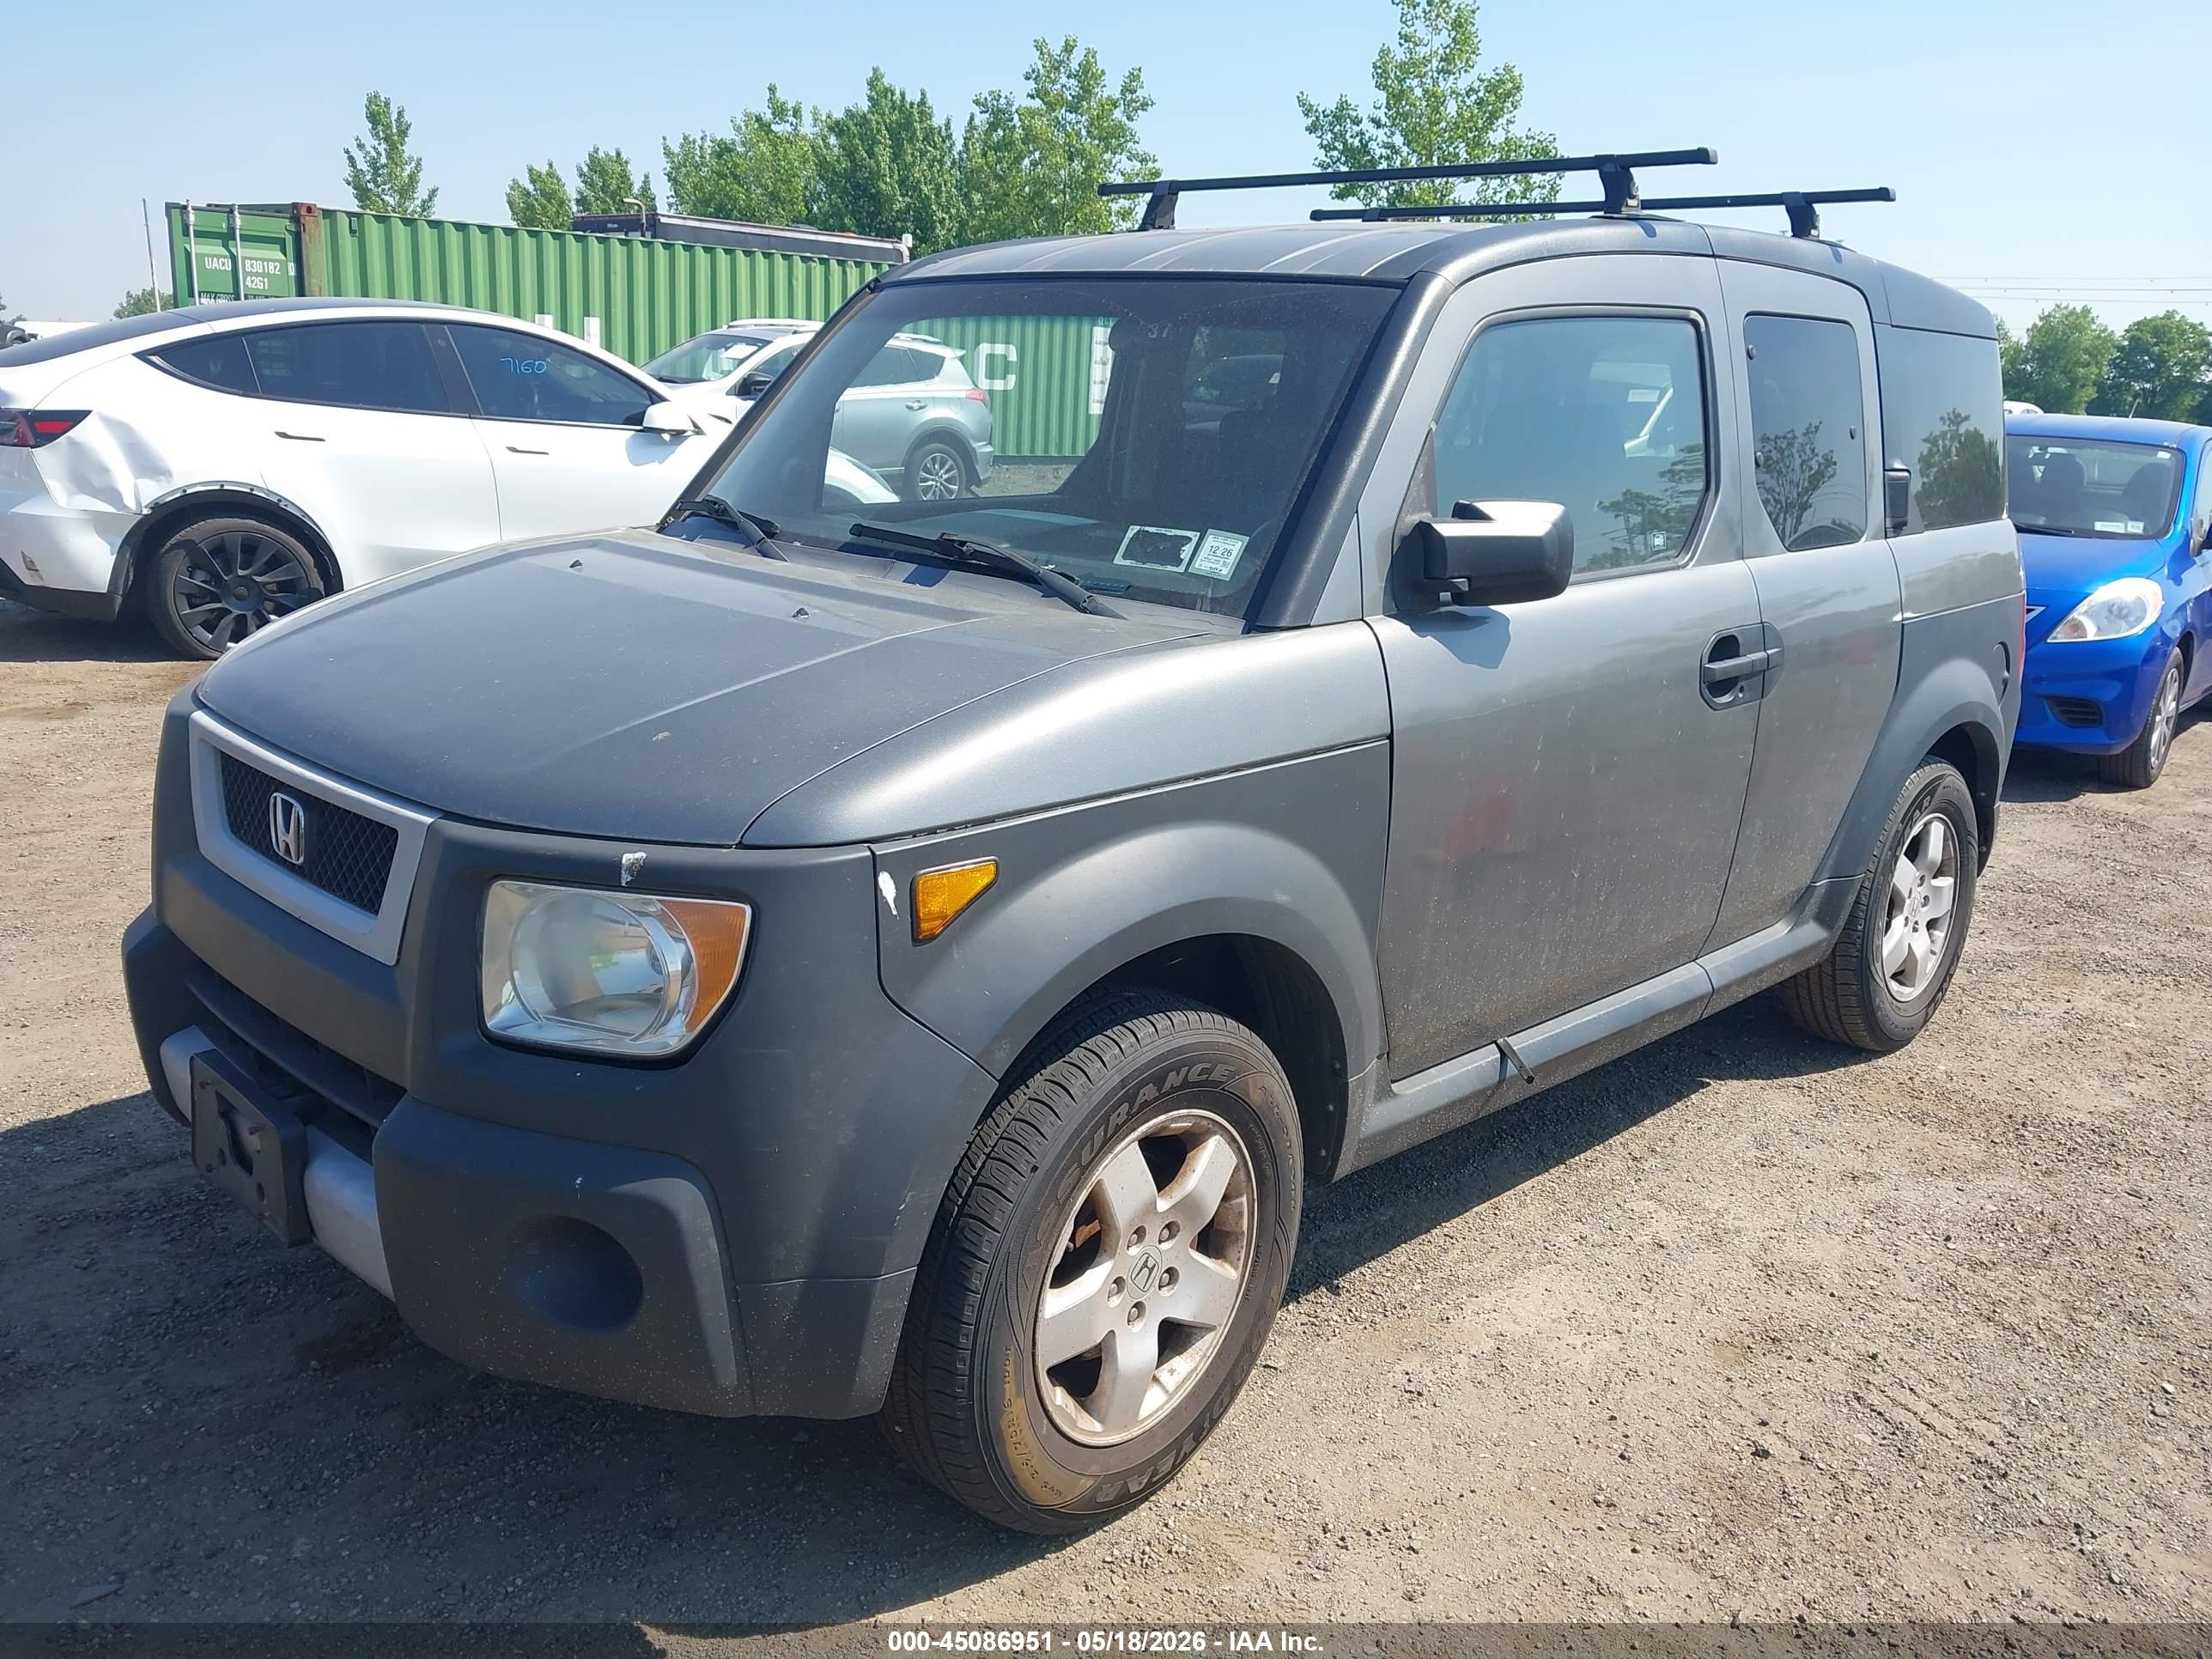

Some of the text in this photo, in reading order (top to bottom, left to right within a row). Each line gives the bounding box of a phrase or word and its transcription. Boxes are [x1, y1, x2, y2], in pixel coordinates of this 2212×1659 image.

[205, 257, 232, 271] UACU
[245, 259, 281, 275] 830182
[245, 276, 268, 289] 42G1
[500, 357, 547, 374] 7160
[1020, 1061, 1237, 1292] ASSURANCE
